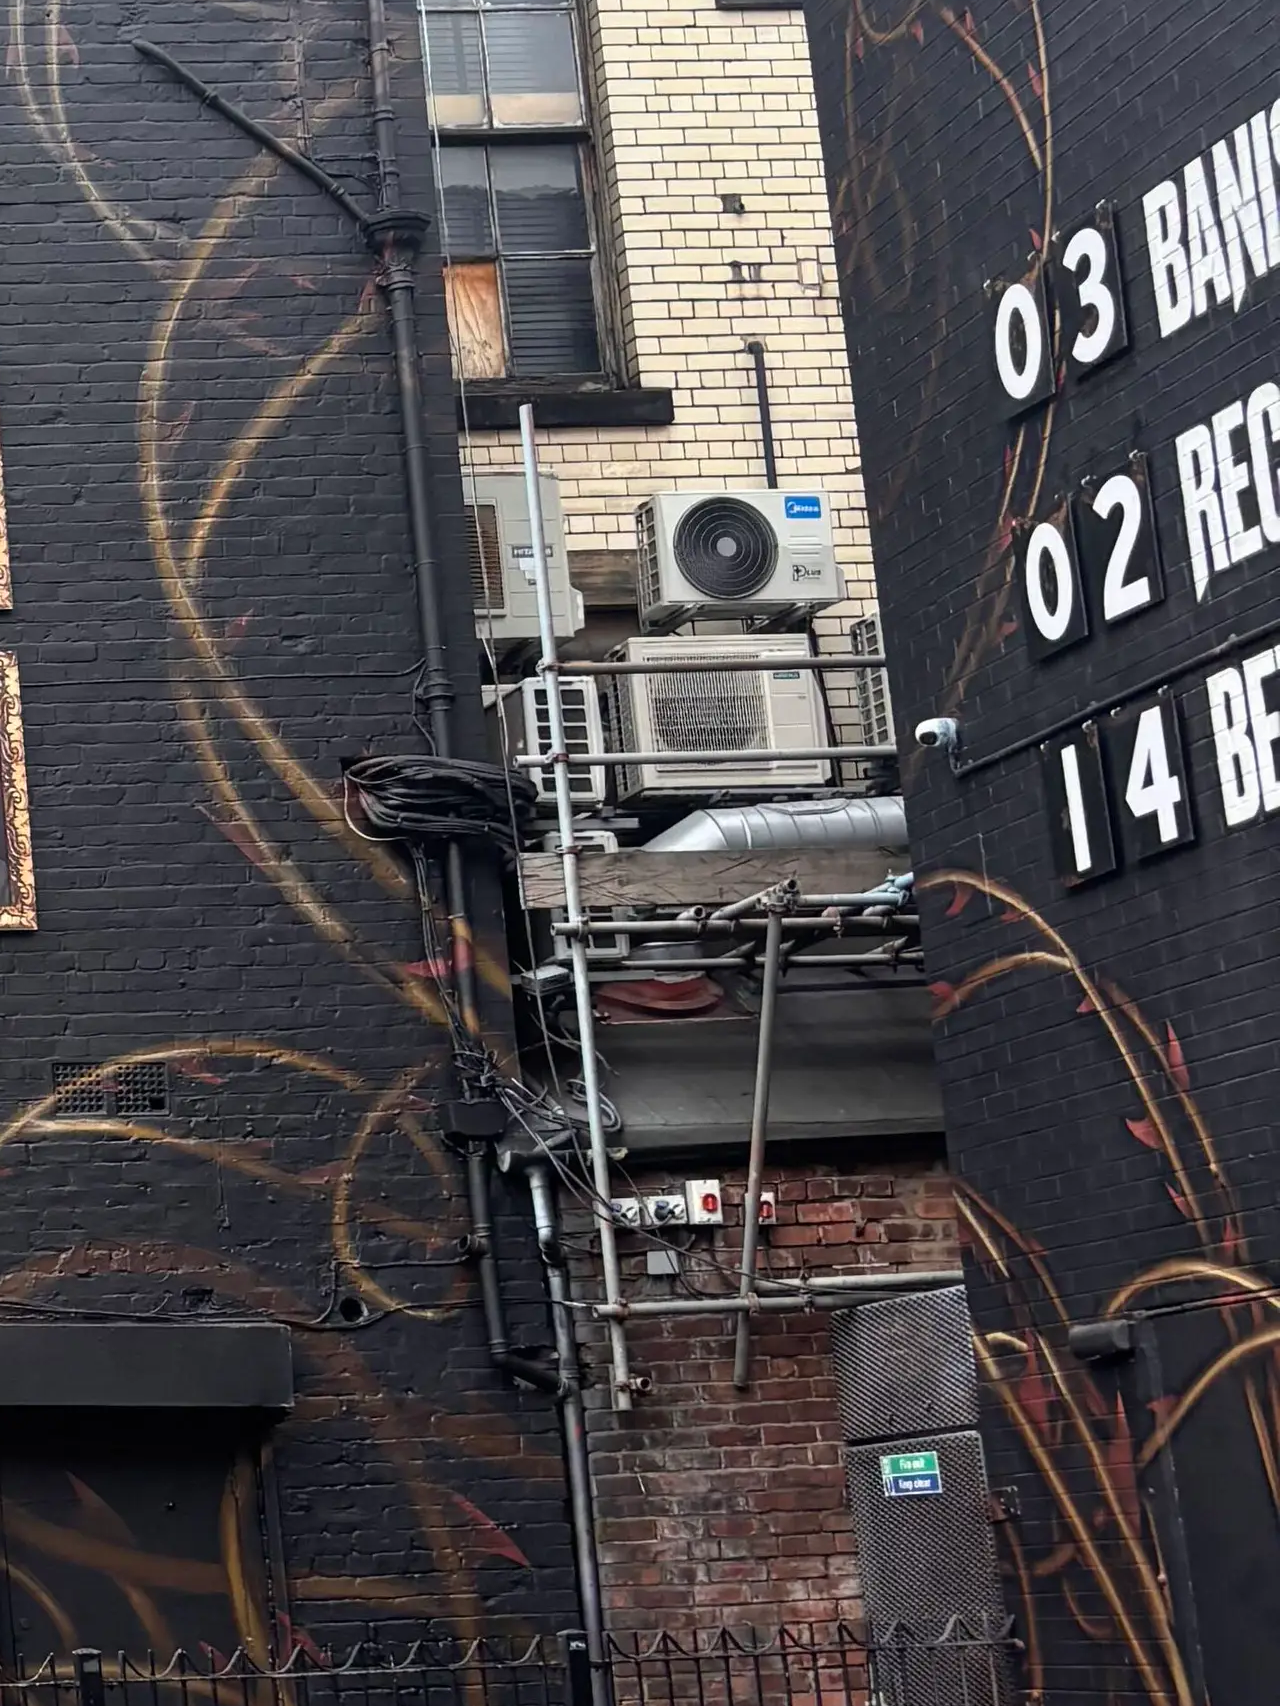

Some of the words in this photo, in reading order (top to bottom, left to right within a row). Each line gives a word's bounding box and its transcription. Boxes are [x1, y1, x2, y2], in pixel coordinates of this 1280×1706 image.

[995, 228, 1115, 400] 03
[1142, 97, 1280, 338] BANI
[1026, 475, 1151, 641] 02
[1061, 706, 1181, 872] 14
[1206, 644, 1280, 827] BE
